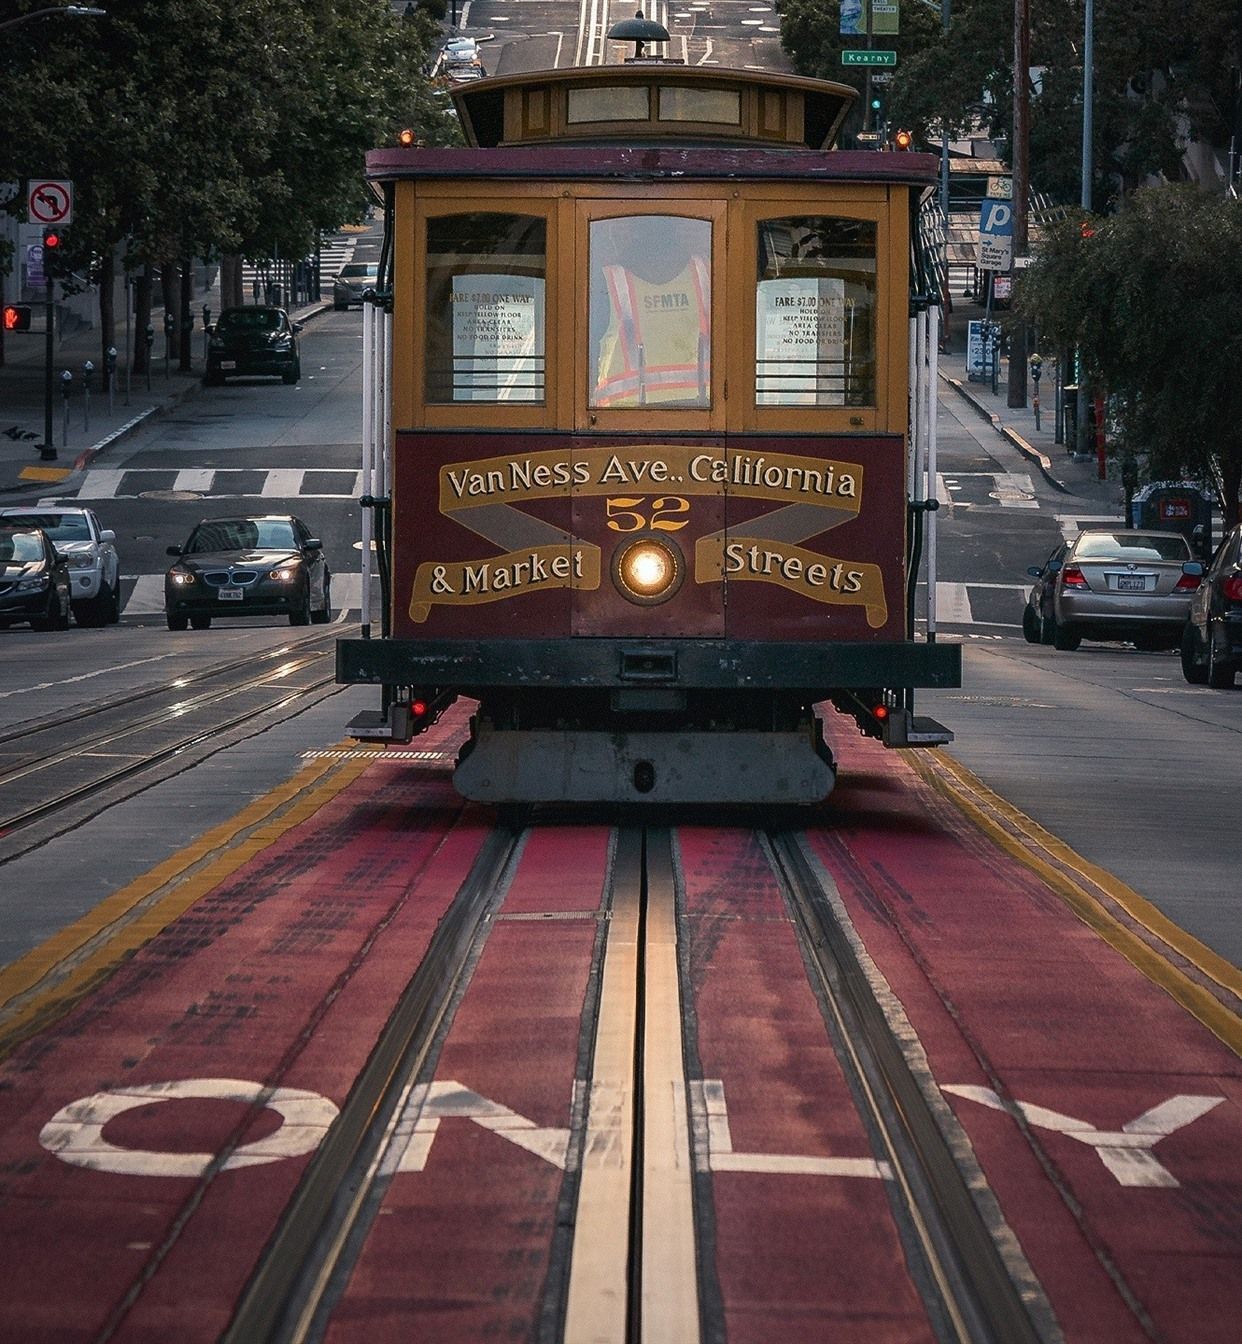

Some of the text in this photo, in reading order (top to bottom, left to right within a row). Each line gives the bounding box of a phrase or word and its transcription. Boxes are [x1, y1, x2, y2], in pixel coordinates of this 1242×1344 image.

[848, 54, 889, 63] Kearny
[990, 247, 1009, 256] Mary's
[493, 293, 510, 303] ONE
[513, 294, 530, 303] WAY
[643, 293, 689, 308] SFMTA
[775, 297, 856, 307] FARE $7.00 ONE WAY
[448, 469, 505, 498] Van
[508, 460, 591, 492] Ness
[689, 454, 856, 497] California
[606, 496, 690, 532] 52
[431, 543, 864, 594] & Market Streets
[38, 1078, 1228, 1189] ONLY
